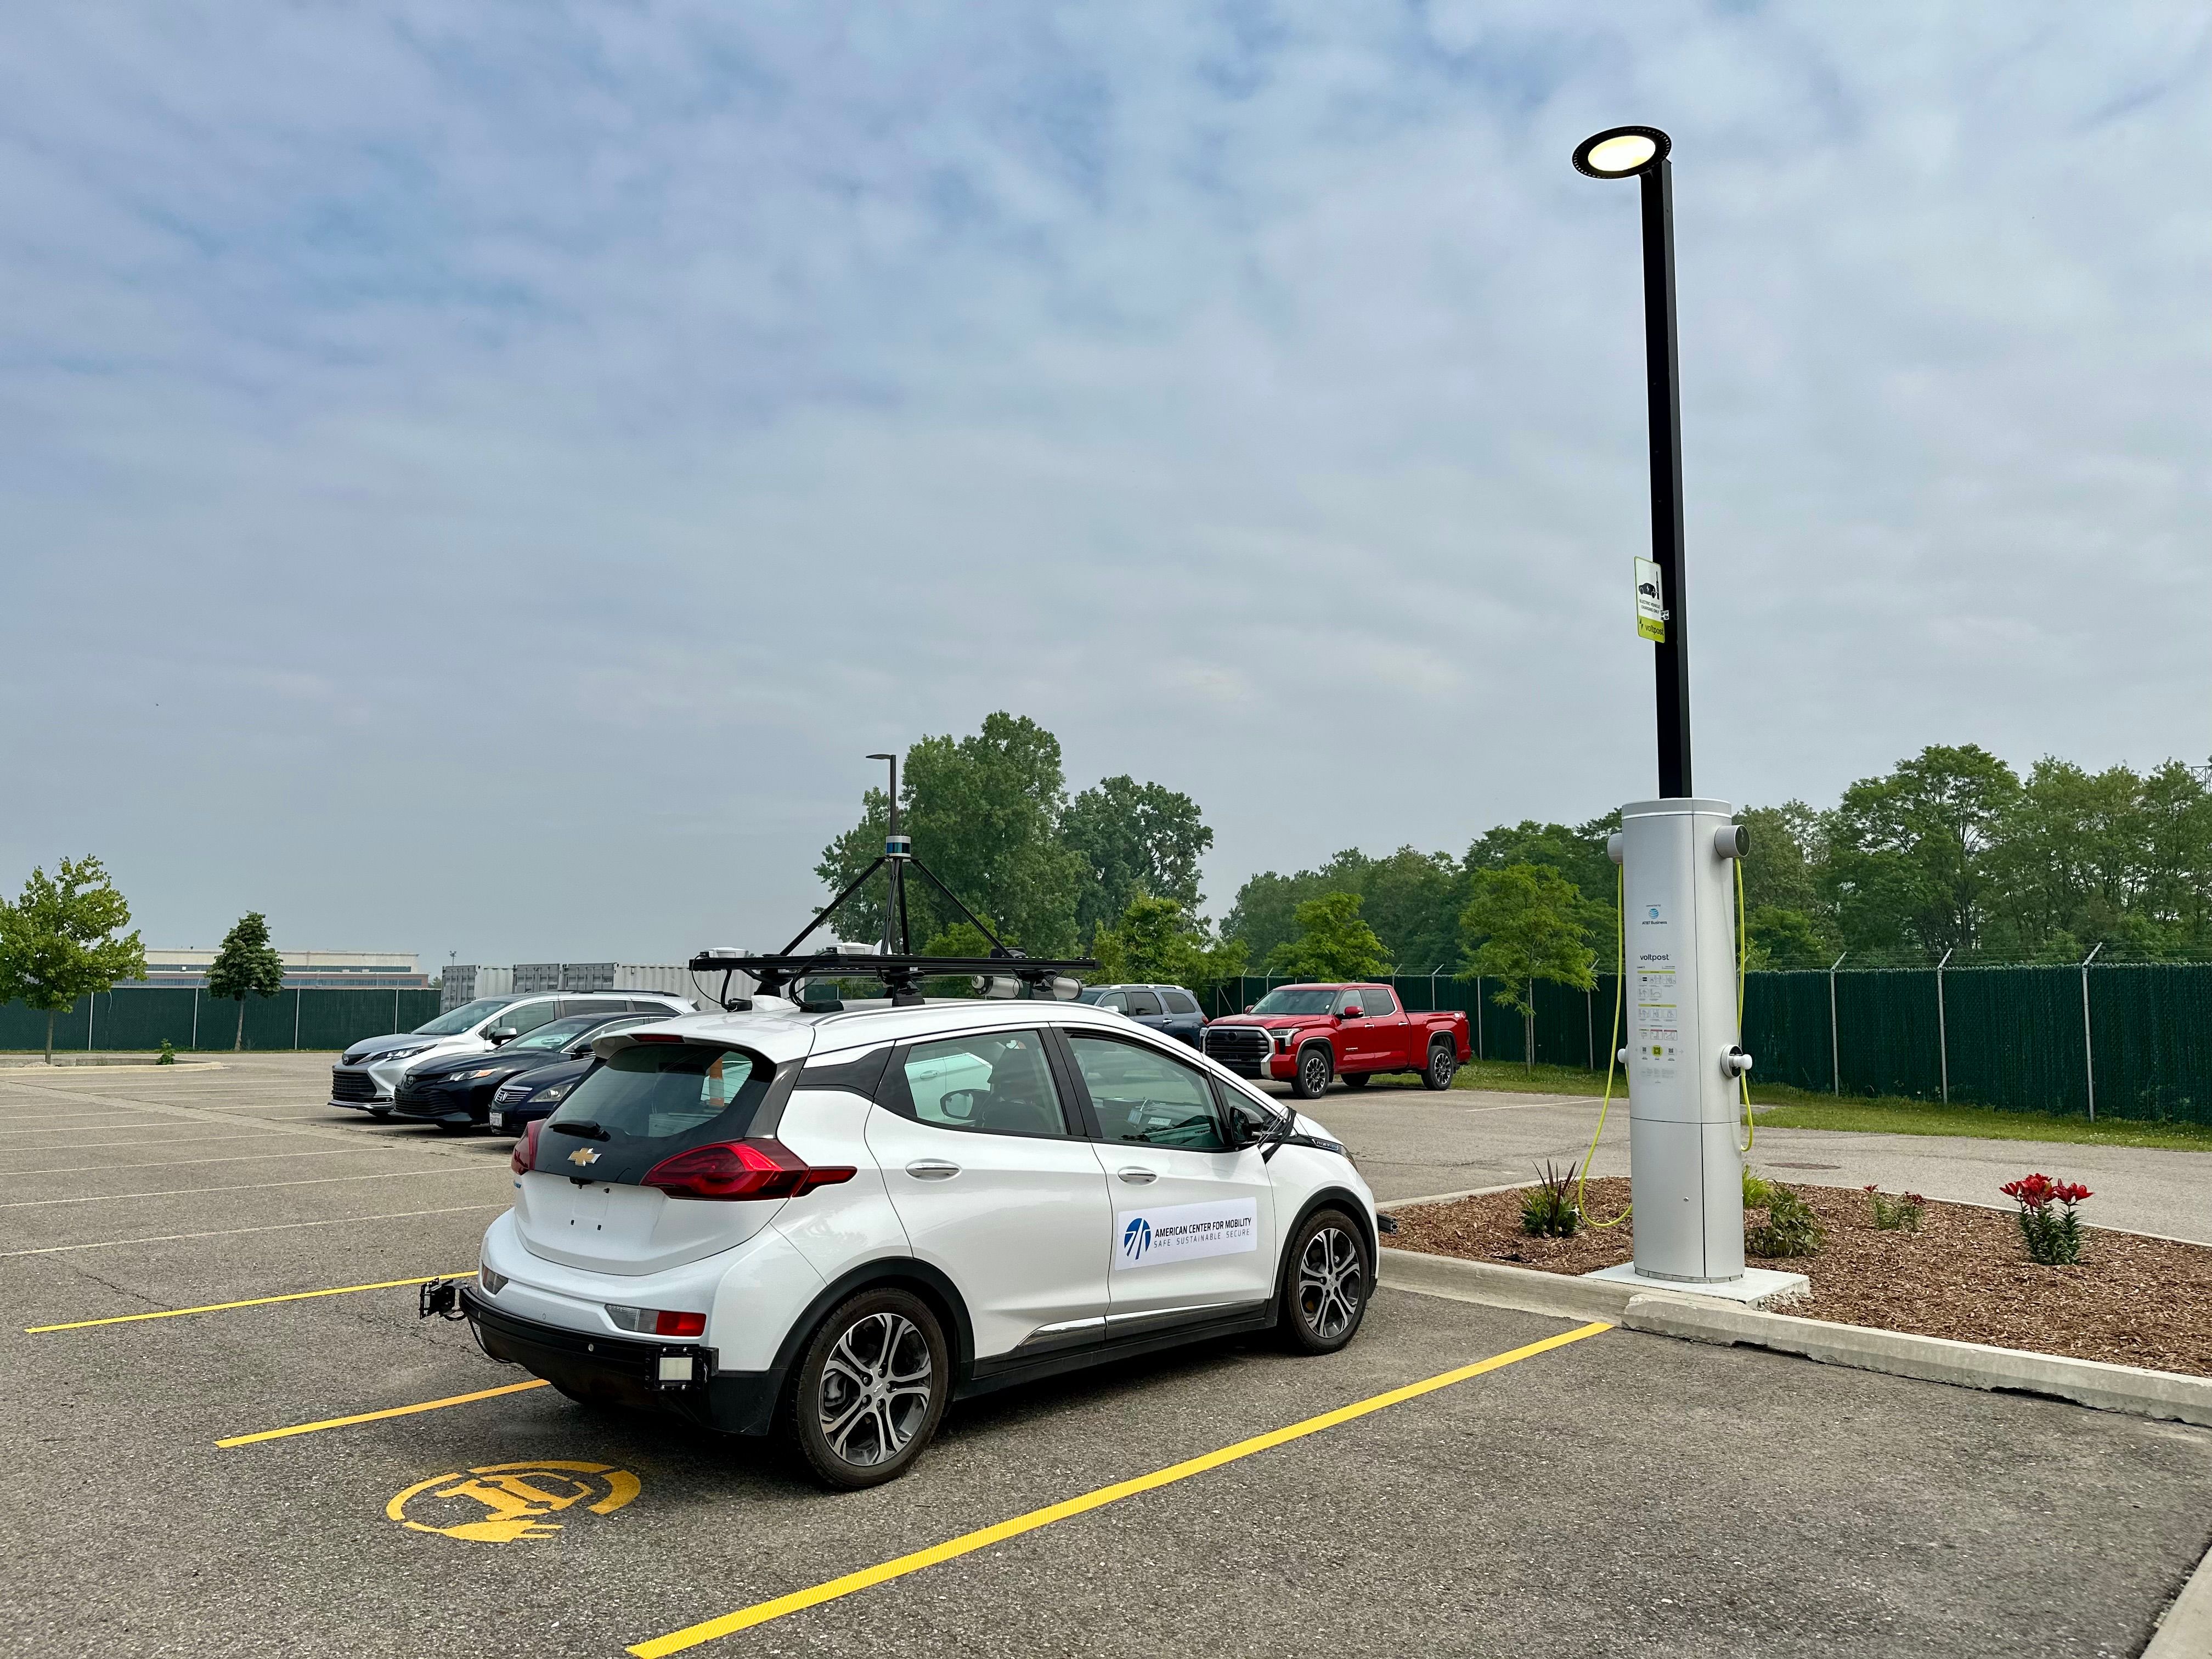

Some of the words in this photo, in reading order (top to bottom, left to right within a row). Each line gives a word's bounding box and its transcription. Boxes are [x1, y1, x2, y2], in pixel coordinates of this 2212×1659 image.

[1645, 625, 1664, 635] voltpost
[1639, 953, 1669, 962] voltpost
[1155, 1226, 1187, 1238] AMERICAN
[1189, 1222, 1211, 1234] CENTER
[1212, 1221, 1224, 1231] FOR
[1225, 1217, 1251, 1229] MOBILITY
